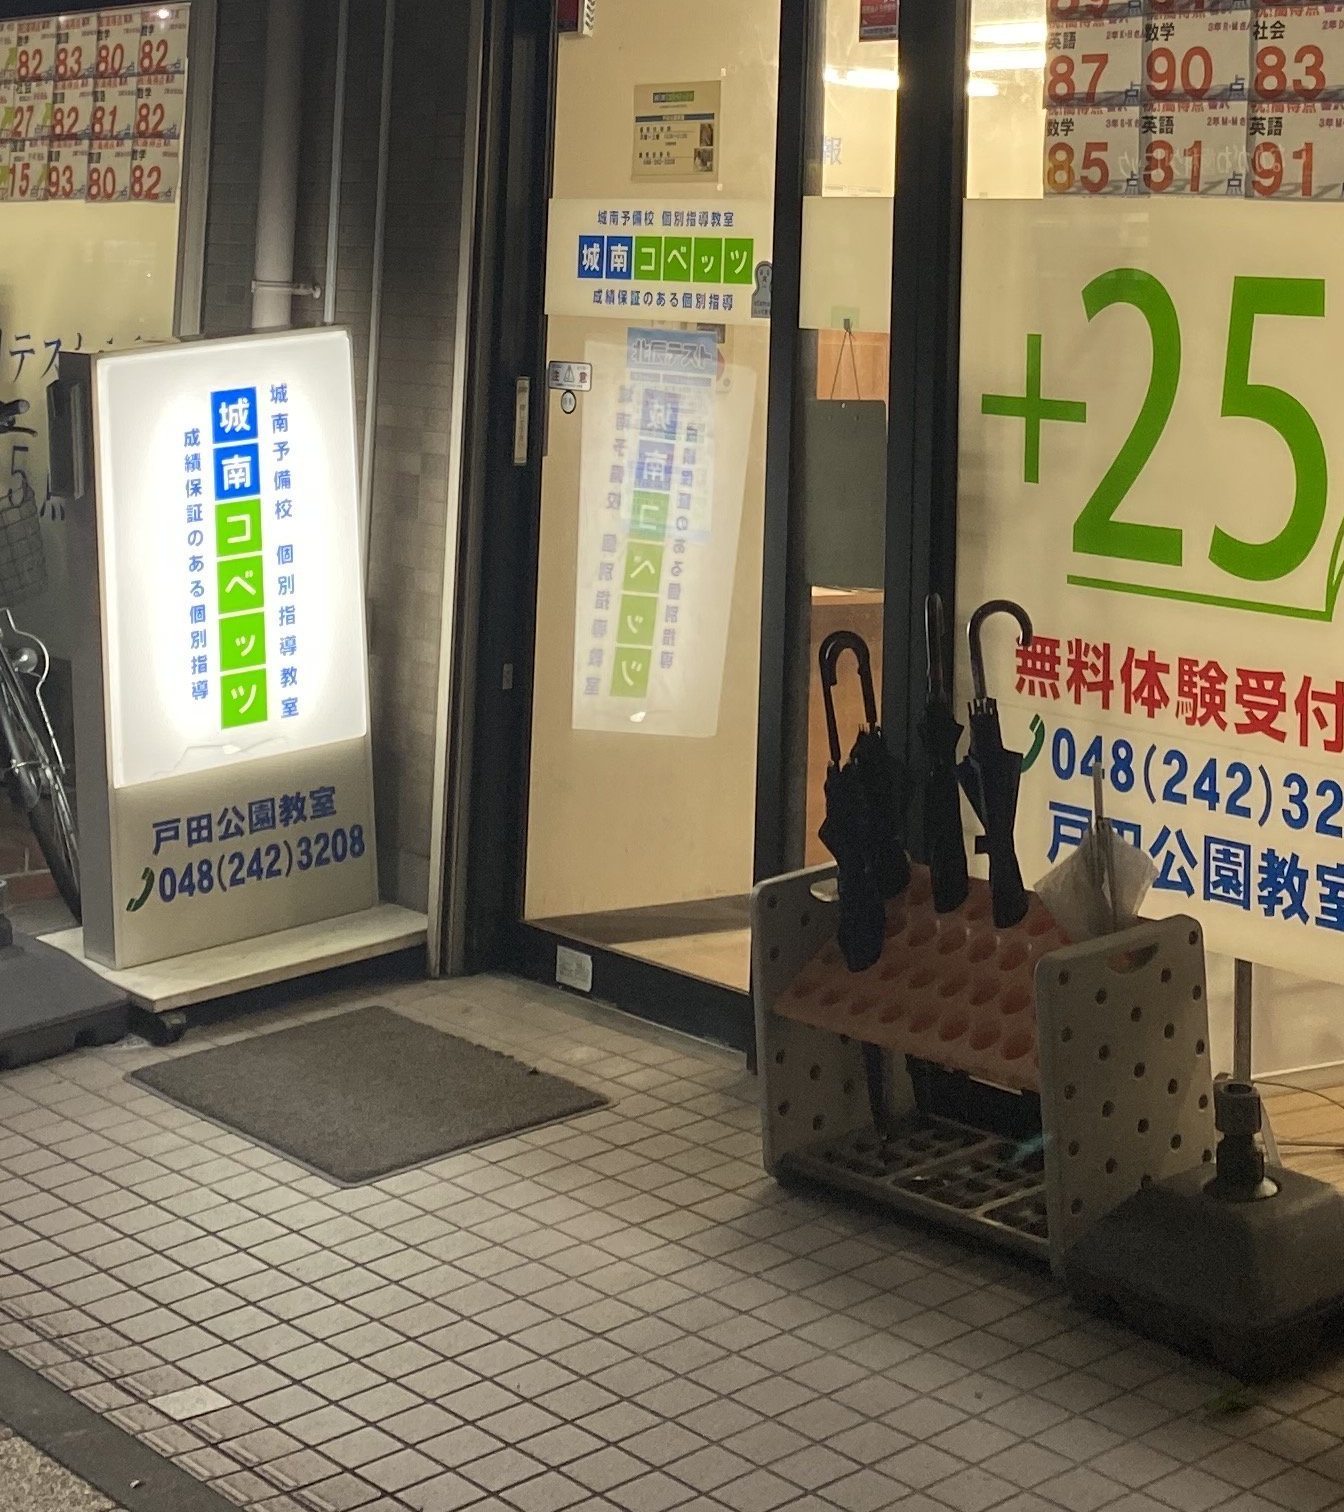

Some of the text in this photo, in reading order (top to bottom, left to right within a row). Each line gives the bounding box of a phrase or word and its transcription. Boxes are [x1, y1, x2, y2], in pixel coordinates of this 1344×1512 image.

[1145, 23, 1175, 42] 数学
[1253, 20, 1286, 40] 社会
[17, 49, 43, 80] 82
[56, 46, 82, 79] 83
[97, 43, 124, 76] 80
[140, 39, 168, 73] 82
[1146, 46, 1213, 100] 90
[1254, 44, 1326, 101] 83
[1048, 53, 1109, 104] 87
[92, 105, 117, 136] 81
[136, 103, 165, 135] 82
[1047, 118, 1074, 137] 数学
[1141, 115, 1174, 135] 英語
[1249, 116, 1283, 136] 英語
[87, 167, 116, 200] 80
[132, 164, 162, 199] 82
[1047, 141, 1109, 193] 85
[1143, 140, 1202, 193] 81
[1251, 141, 1313, 197] 91
[581, 242, 748, 275] 城南コベッツ
[182, 427, 210, 702] 成績保証のある個別指導
[217, 395, 262, 718] 城南コベッツ
[269, 383, 300, 721] 城南予備校 個別指導教室
[150, 785, 339, 857] 戸田公園教室
[158, 824, 367, 905] 048(242)3208
